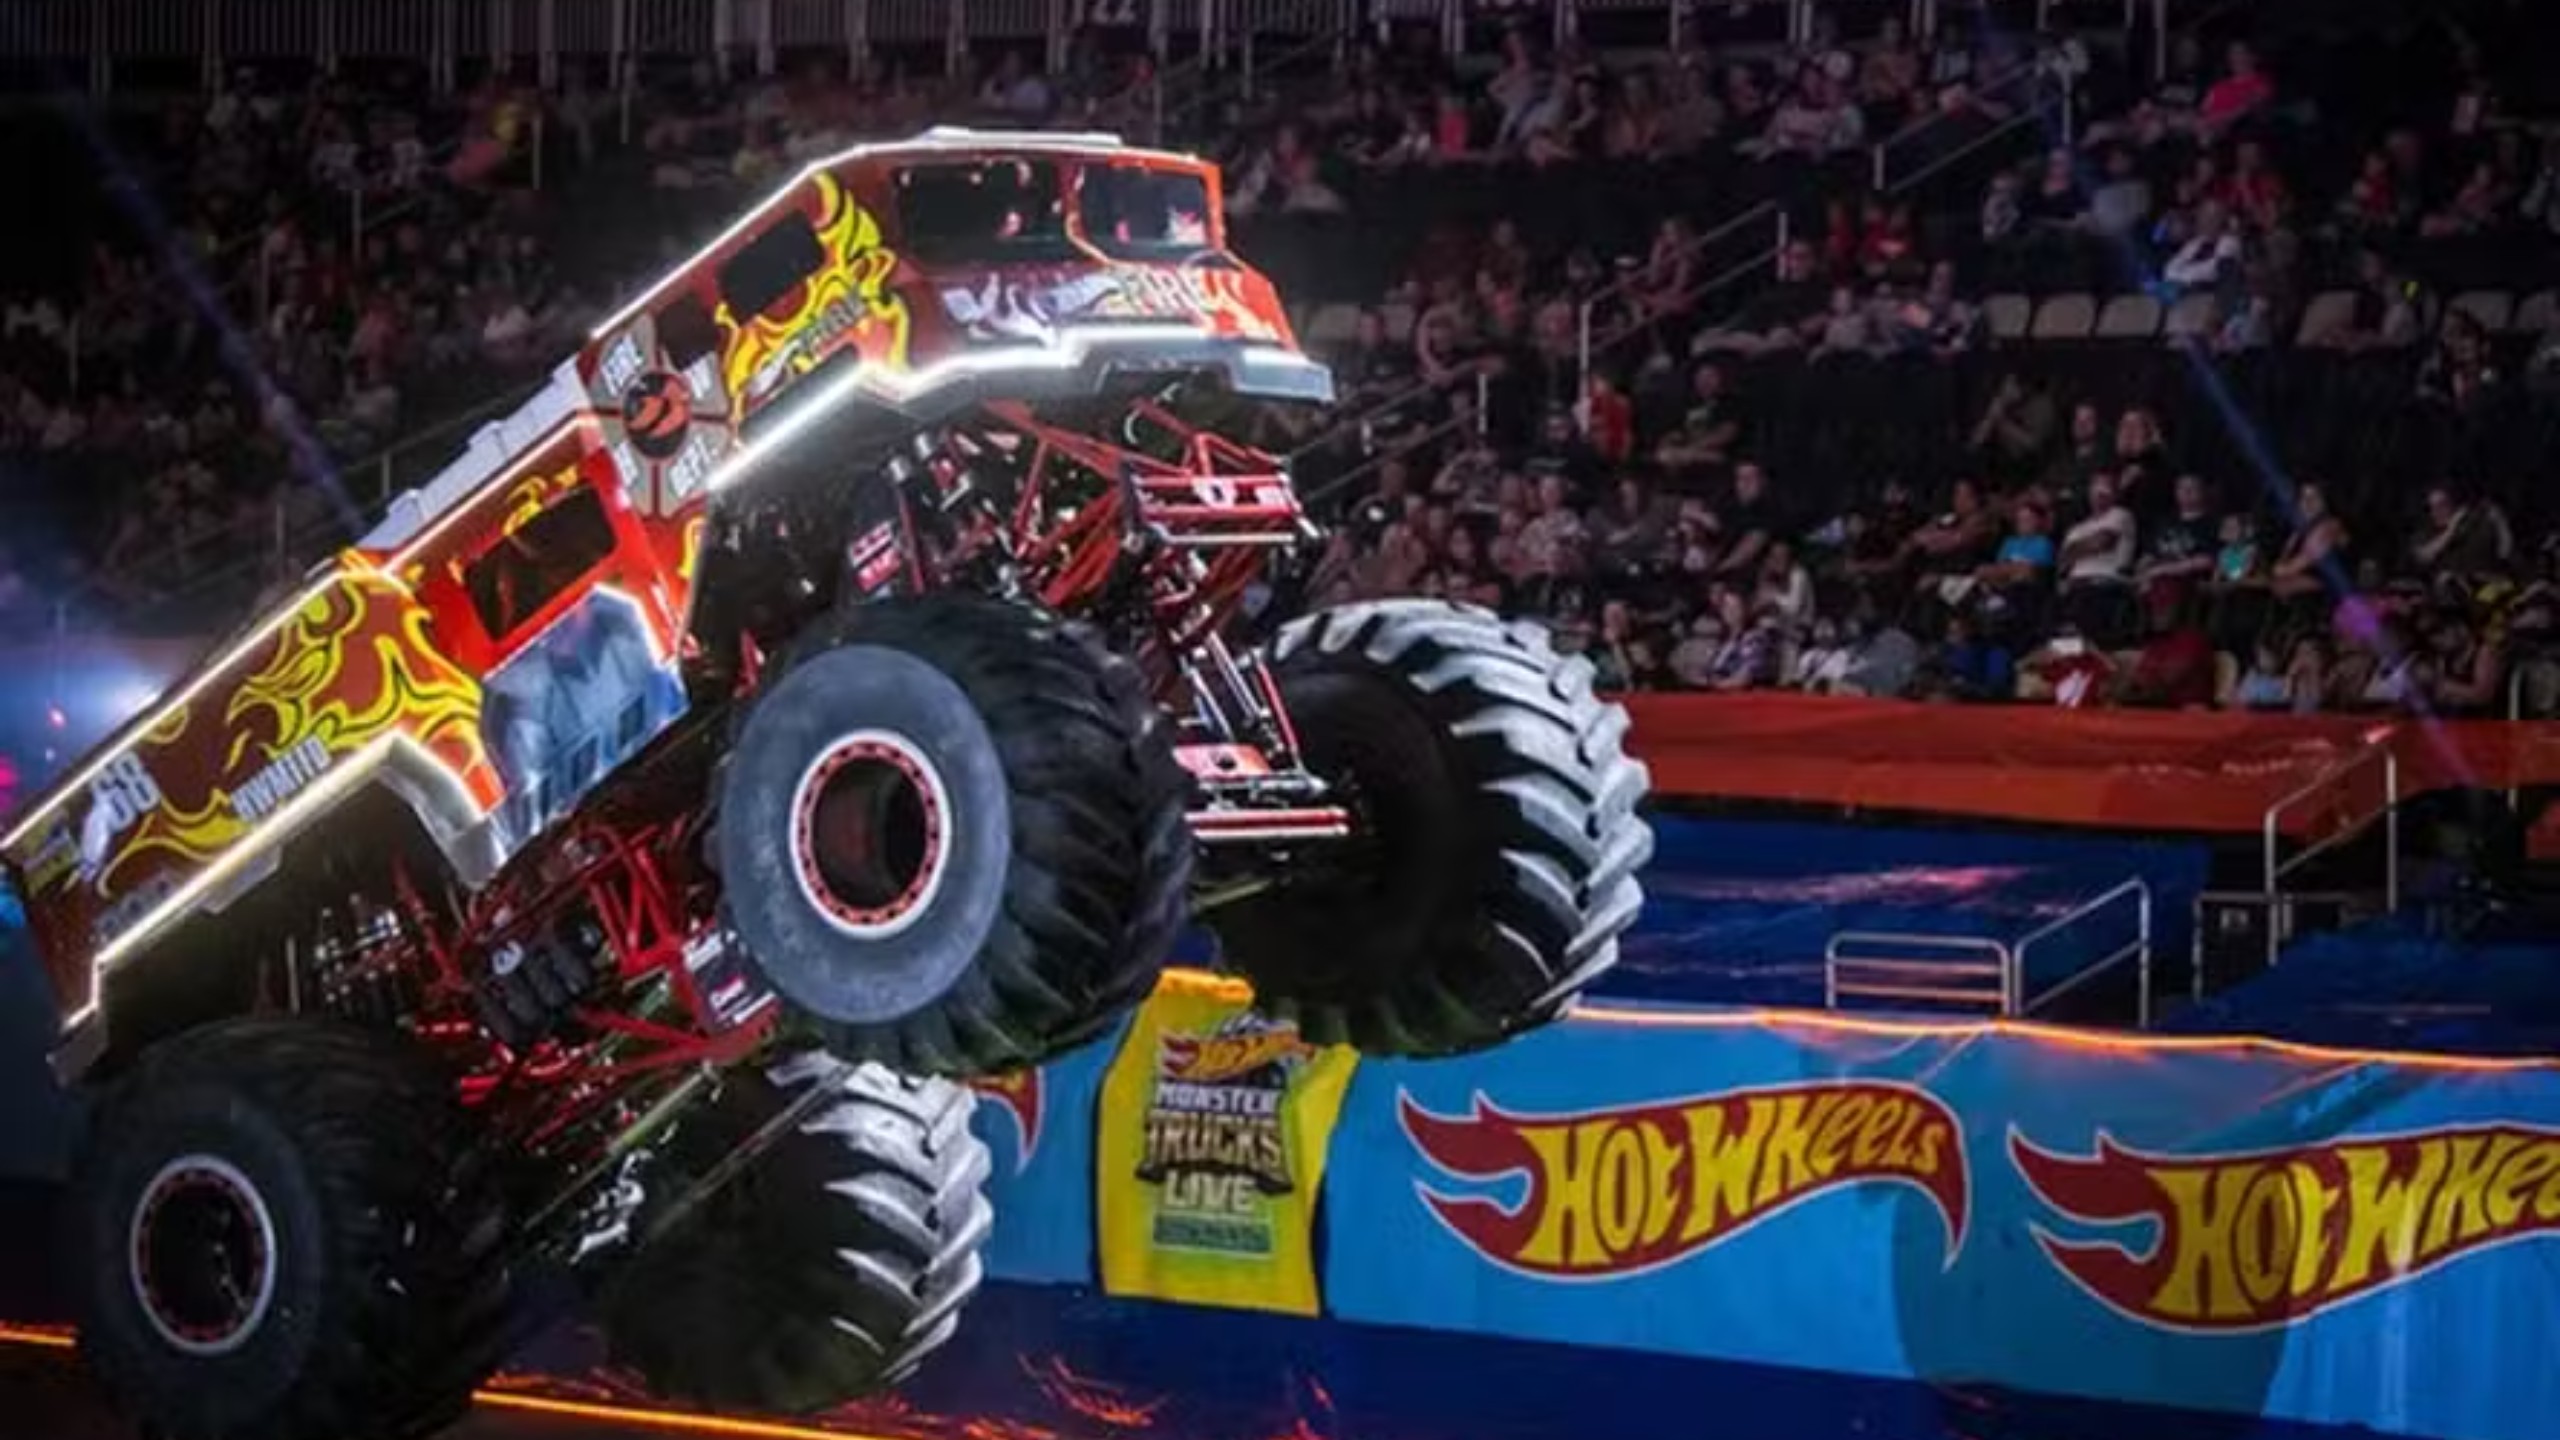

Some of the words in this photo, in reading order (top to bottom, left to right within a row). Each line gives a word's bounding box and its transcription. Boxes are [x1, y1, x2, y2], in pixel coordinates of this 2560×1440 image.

[1156, 1081, 1279, 1115] MONSTER
[1146, 1111, 1282, 1172] TRUCKS
[1165, 1169, 1257, 1213] LIVE
[1515, 1118, 1683, 1267] HOT
[2145, 1162, 2338, 1318] HOT
